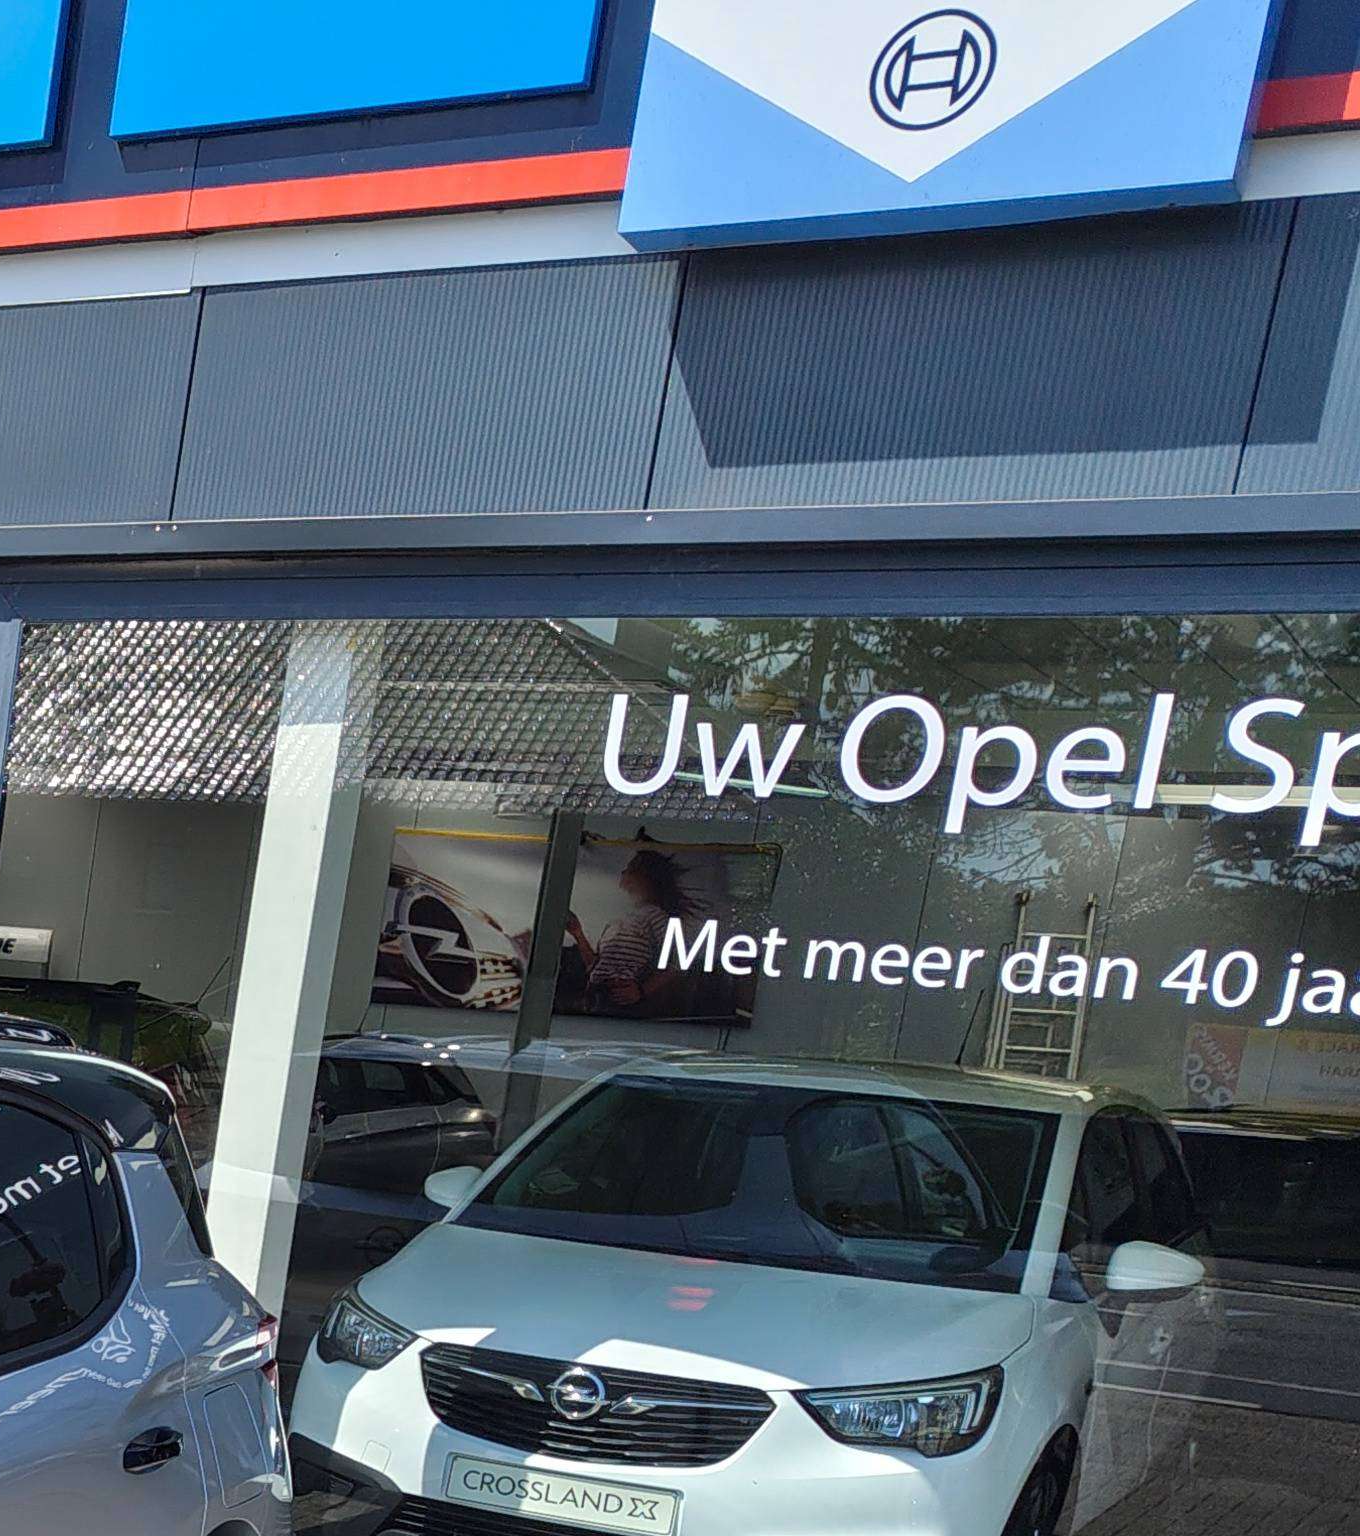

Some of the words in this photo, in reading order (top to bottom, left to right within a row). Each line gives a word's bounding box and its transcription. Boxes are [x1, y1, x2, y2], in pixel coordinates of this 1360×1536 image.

[603, 694, 806, 796] Uw
[839, 693, 1174, 834] Opel
[656, 917, 786, 978] Met
[803, 939, 984, 989] meer
[1000, 937, 1138, 1000] dan
[1161, 949, 1257, 1008] 40
[463, 1470, 623, 1514] CROSSLAND
[628, 1496, 659, 1521] X
